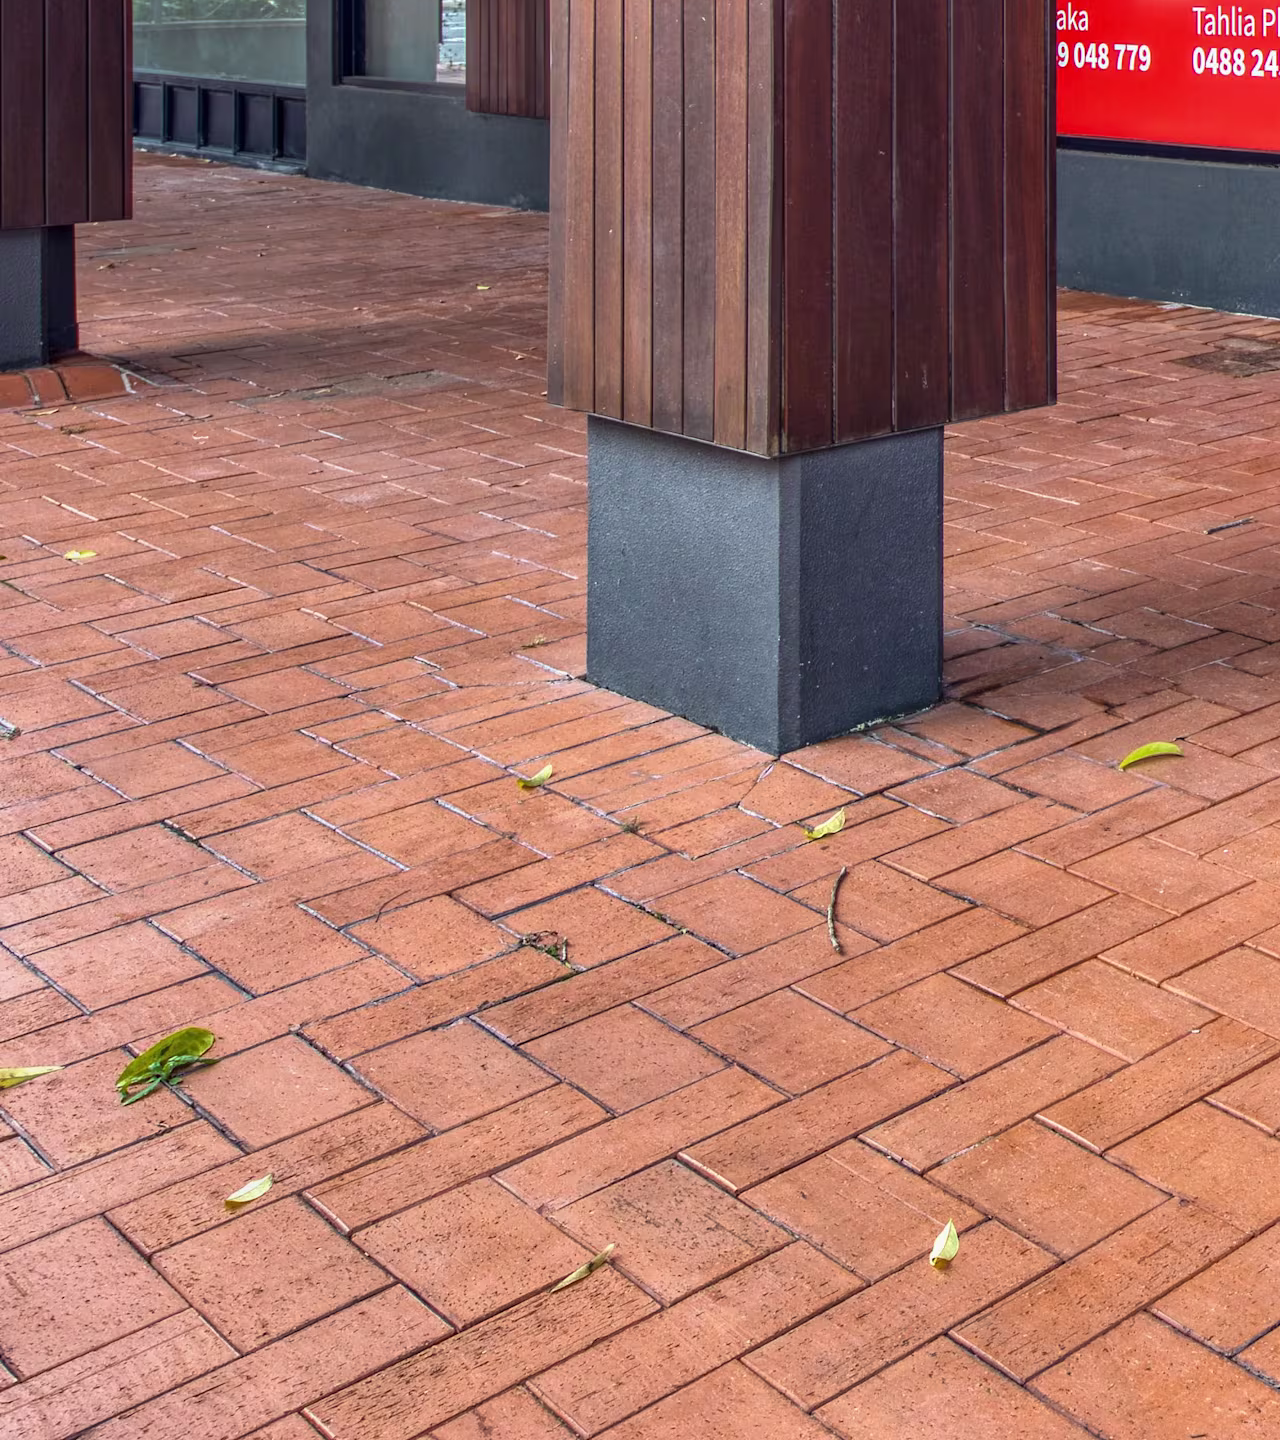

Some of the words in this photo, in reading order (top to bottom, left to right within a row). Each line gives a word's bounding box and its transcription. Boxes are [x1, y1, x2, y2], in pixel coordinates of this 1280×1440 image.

[1056, 2, 1089, 31] aka
[1192, 6, 1255, 37] Tahlia
[1073, 42, 1109, 70] 048
[1114, 43, 1151, 72] 779
[1192, 46, 1245, 76] 0488
